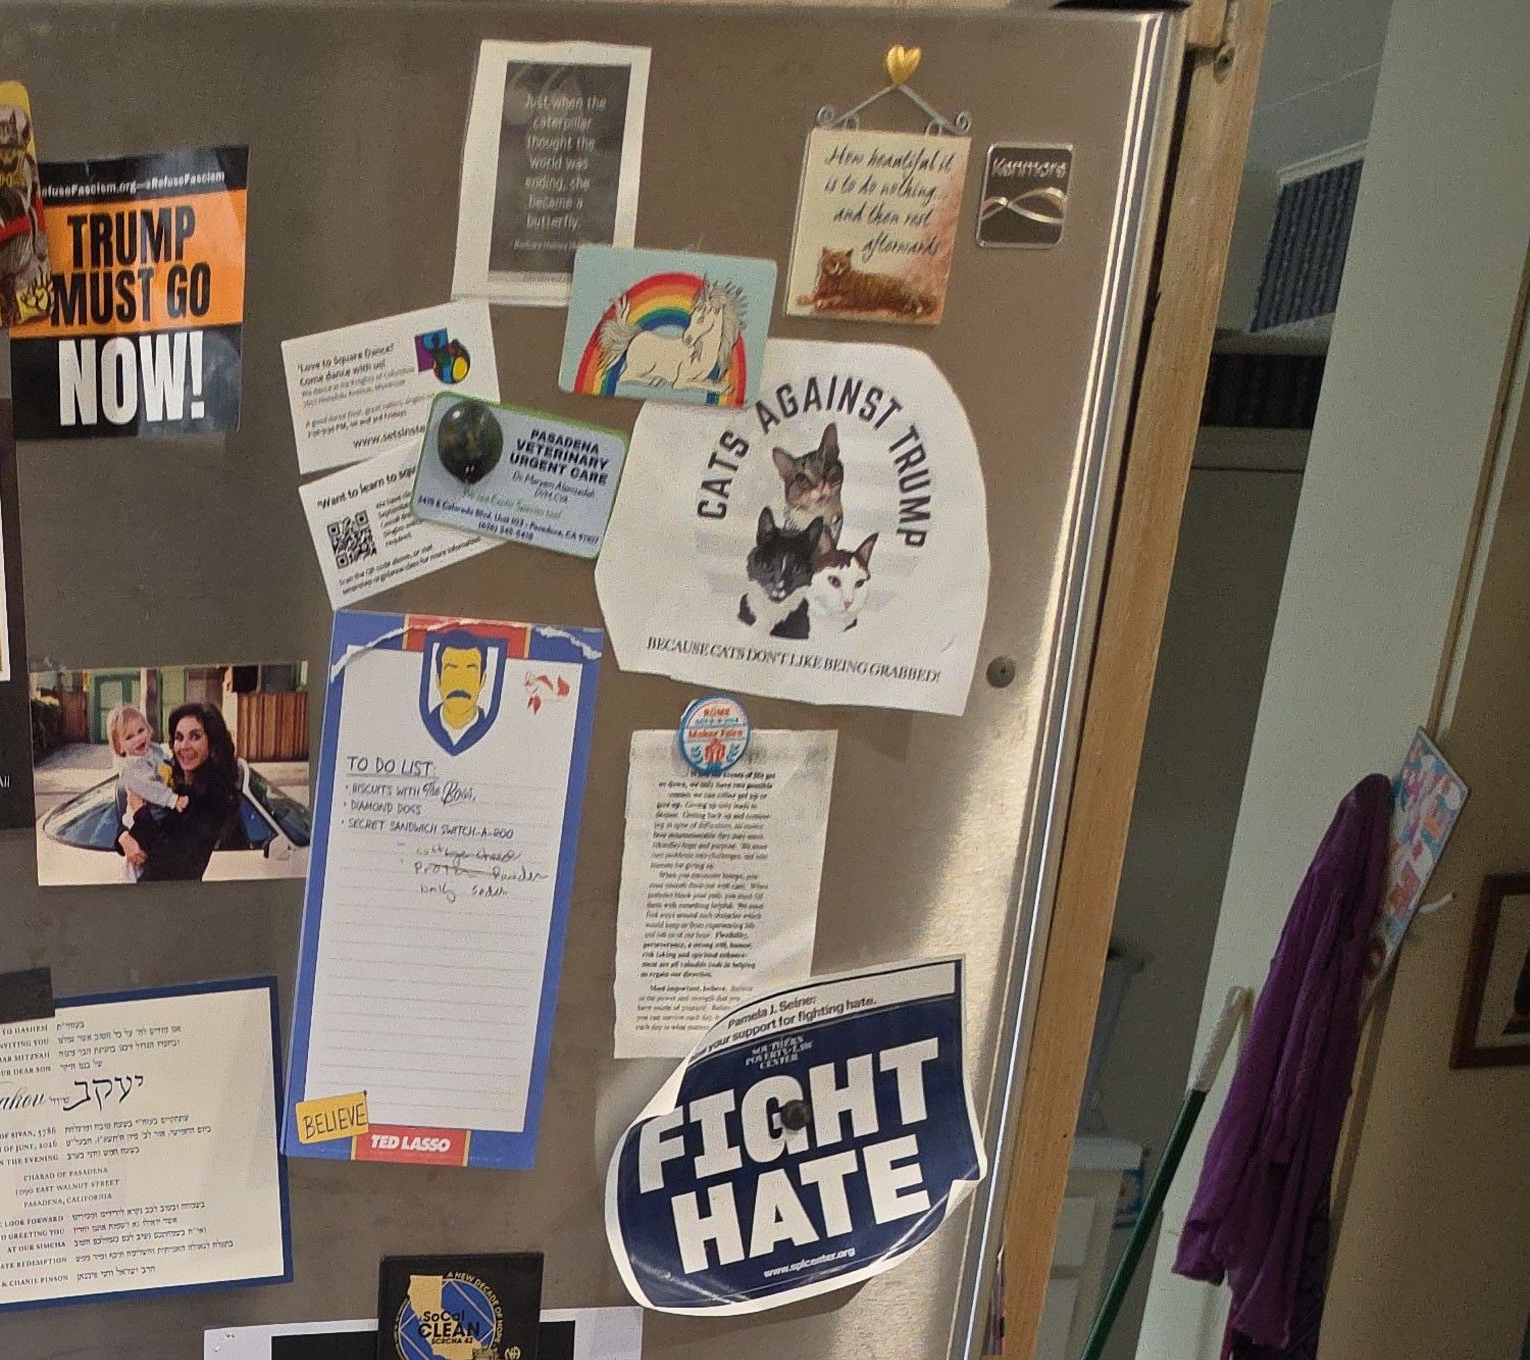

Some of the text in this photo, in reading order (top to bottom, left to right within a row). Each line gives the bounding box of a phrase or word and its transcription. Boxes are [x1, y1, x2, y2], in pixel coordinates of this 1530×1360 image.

[553, 95, 583, 110] when
[587, 95, 606, 110] the
[526, 136, 596, 151] thought the
[529, 156, 588, 170] world was
[827, 144, 955, 178] How beautiful it
[570, 176, 590, 190] she
[824, 174, 937, 204] is to do nothing
[833, 201, 862, 223] and
[866, 203, 899, 225] then
[67, 205, 196, 270] TRUMP
[50, 262, 211, 327] MUST GO
[59, 331, 205, 425] NOW!
[755, 375, 904, 435] AGAINST
[516, 438, 609, 470] VETERINARY
[530, 428, 600, 455] PASADENA
[510, 452, 609, 486] URGENT CARE
[697, 429, 750, 520] CATS
[888, 424, 933, 548] TRUMP
[647, 636, 710, 657] BECAUSE
[710, 643, 745, 661] CATS
[790, 653, 823, 670] LIKE
[824, 656, 868, 675] BEING
[347, 755, 436, 777] TO DO LIST:
[352, 783, 392, 797] BISCUITS
[396, 786, 420, 797] WITH
[350, 800, 421, 815] DIAMOND DOGS
[348, 818, 384, 831] SECRET
[389, 820, 437, 835] SANDWICH
[733, 1018, 776, 1041] support
[779, 1014, 795, 1028] for
[799, 1003, 845, 1023] fighting
[63, 1074, 145, 1113] יעקב
[303, 1102, 367, 1139] BELIEVE
[638, 1037, 939, 1194] FIGHT
[371, 1134, 451, 1152] TED LASSO
[23, 1167, 108, 1182] CHABAD OF PASADENA
[36, 1179, 120, 1194] EAST WALNUT STREET
[671, 1133, 931, 1275] HATE
[455, 1272, 474, 1283] NEW
[474, 1279, 500, 1306] DECADE
[417, 1322, 480, 1338] CLEAN
[423, 1310, 465, 1322] SoCal
